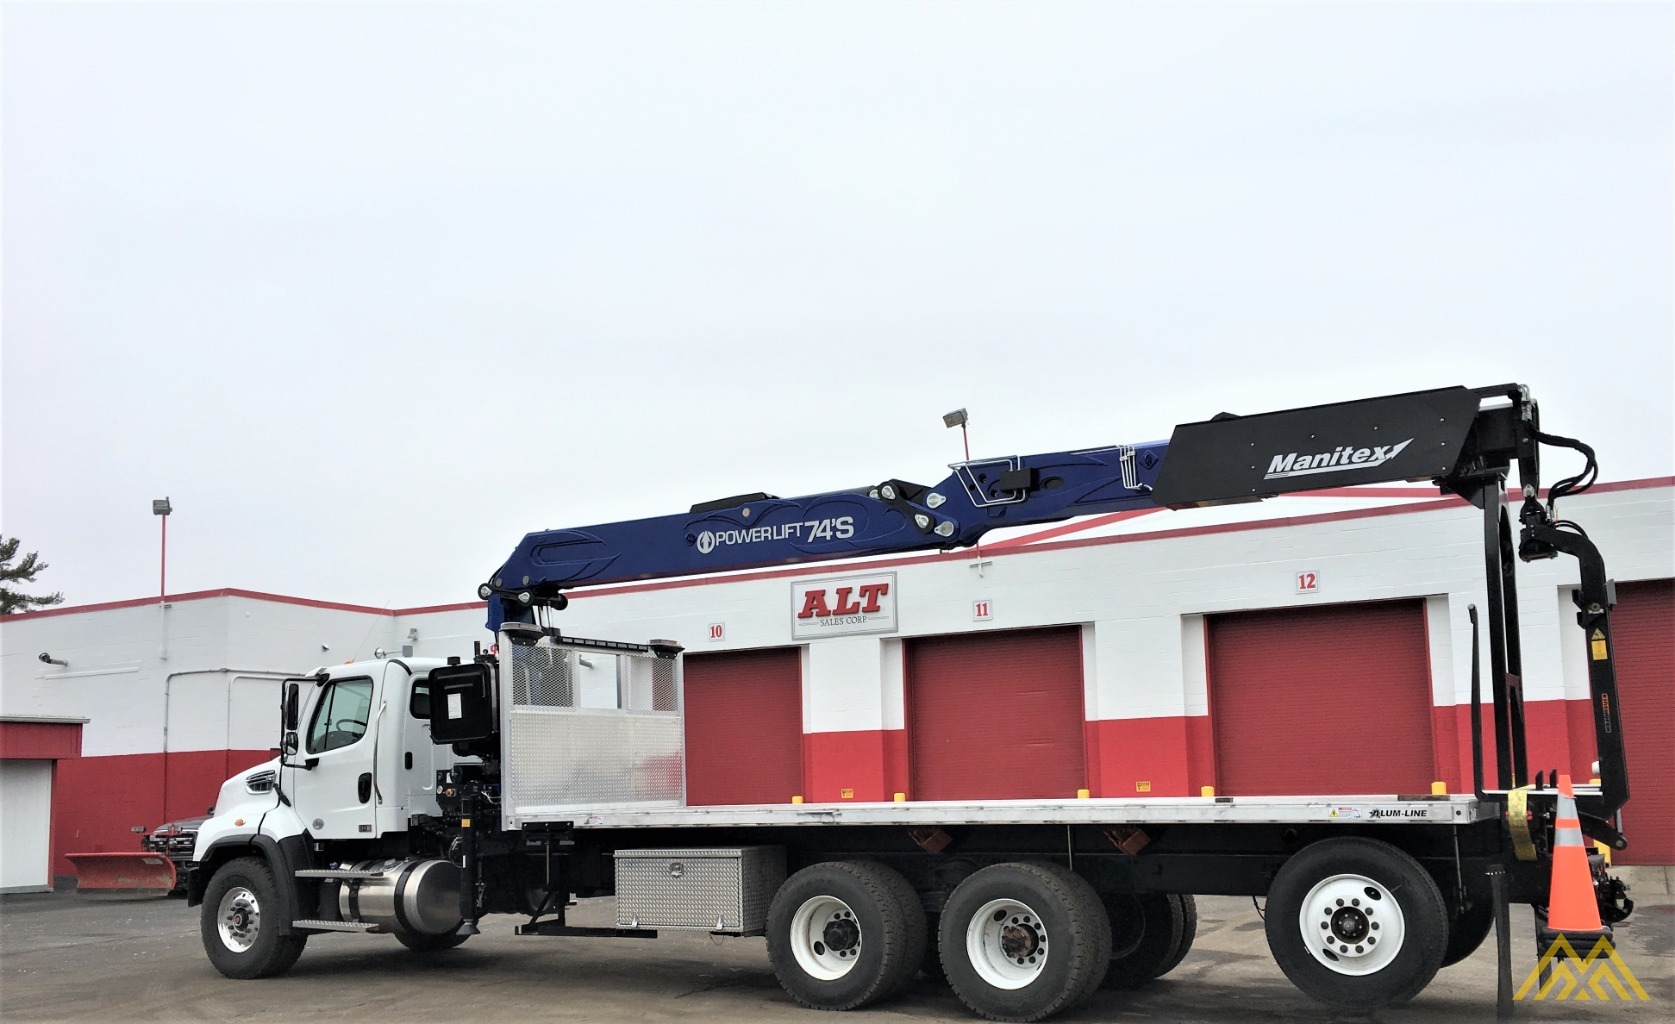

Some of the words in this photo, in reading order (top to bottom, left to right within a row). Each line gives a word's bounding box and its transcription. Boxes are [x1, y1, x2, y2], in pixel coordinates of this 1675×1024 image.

[1267, 445, 1392, 473] Manitex
[804, 516, 855, 543] 74'S
[1298, 573, 1316, 590] 12
[797, 583, 888, 618] ALT
[975, 602, 989, 617] 11
[820, 617, 844, 627] SALES
[710, 625, 723, 639] 10
[1369, 808, 1428, 819] ALUM-LINE
